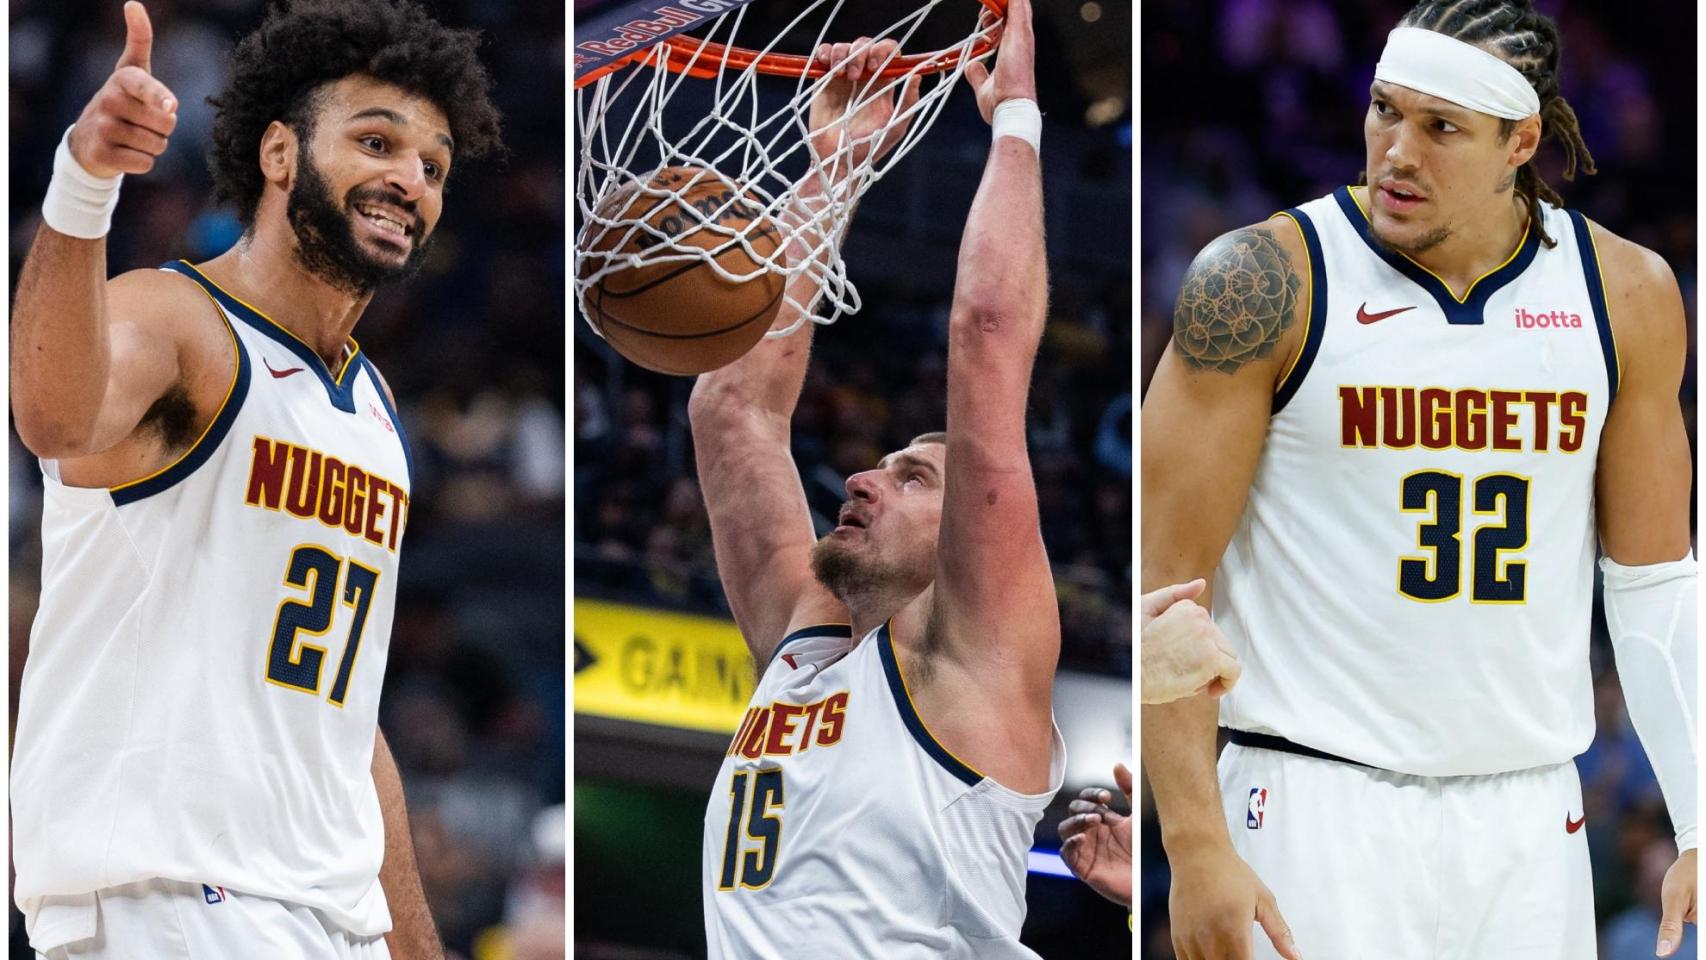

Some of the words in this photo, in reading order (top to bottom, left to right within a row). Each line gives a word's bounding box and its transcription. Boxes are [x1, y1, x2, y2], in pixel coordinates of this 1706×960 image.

[1515, 308, 1583, 329] ibotta
[1337, 384, 1589, 454] NUGGETS
[244, 434, 410, 554] NUGGET
[1397, 468, 1532, 604] 32
[264, 542, 382, 709] 27
[718, 767, 785, 892] 15
